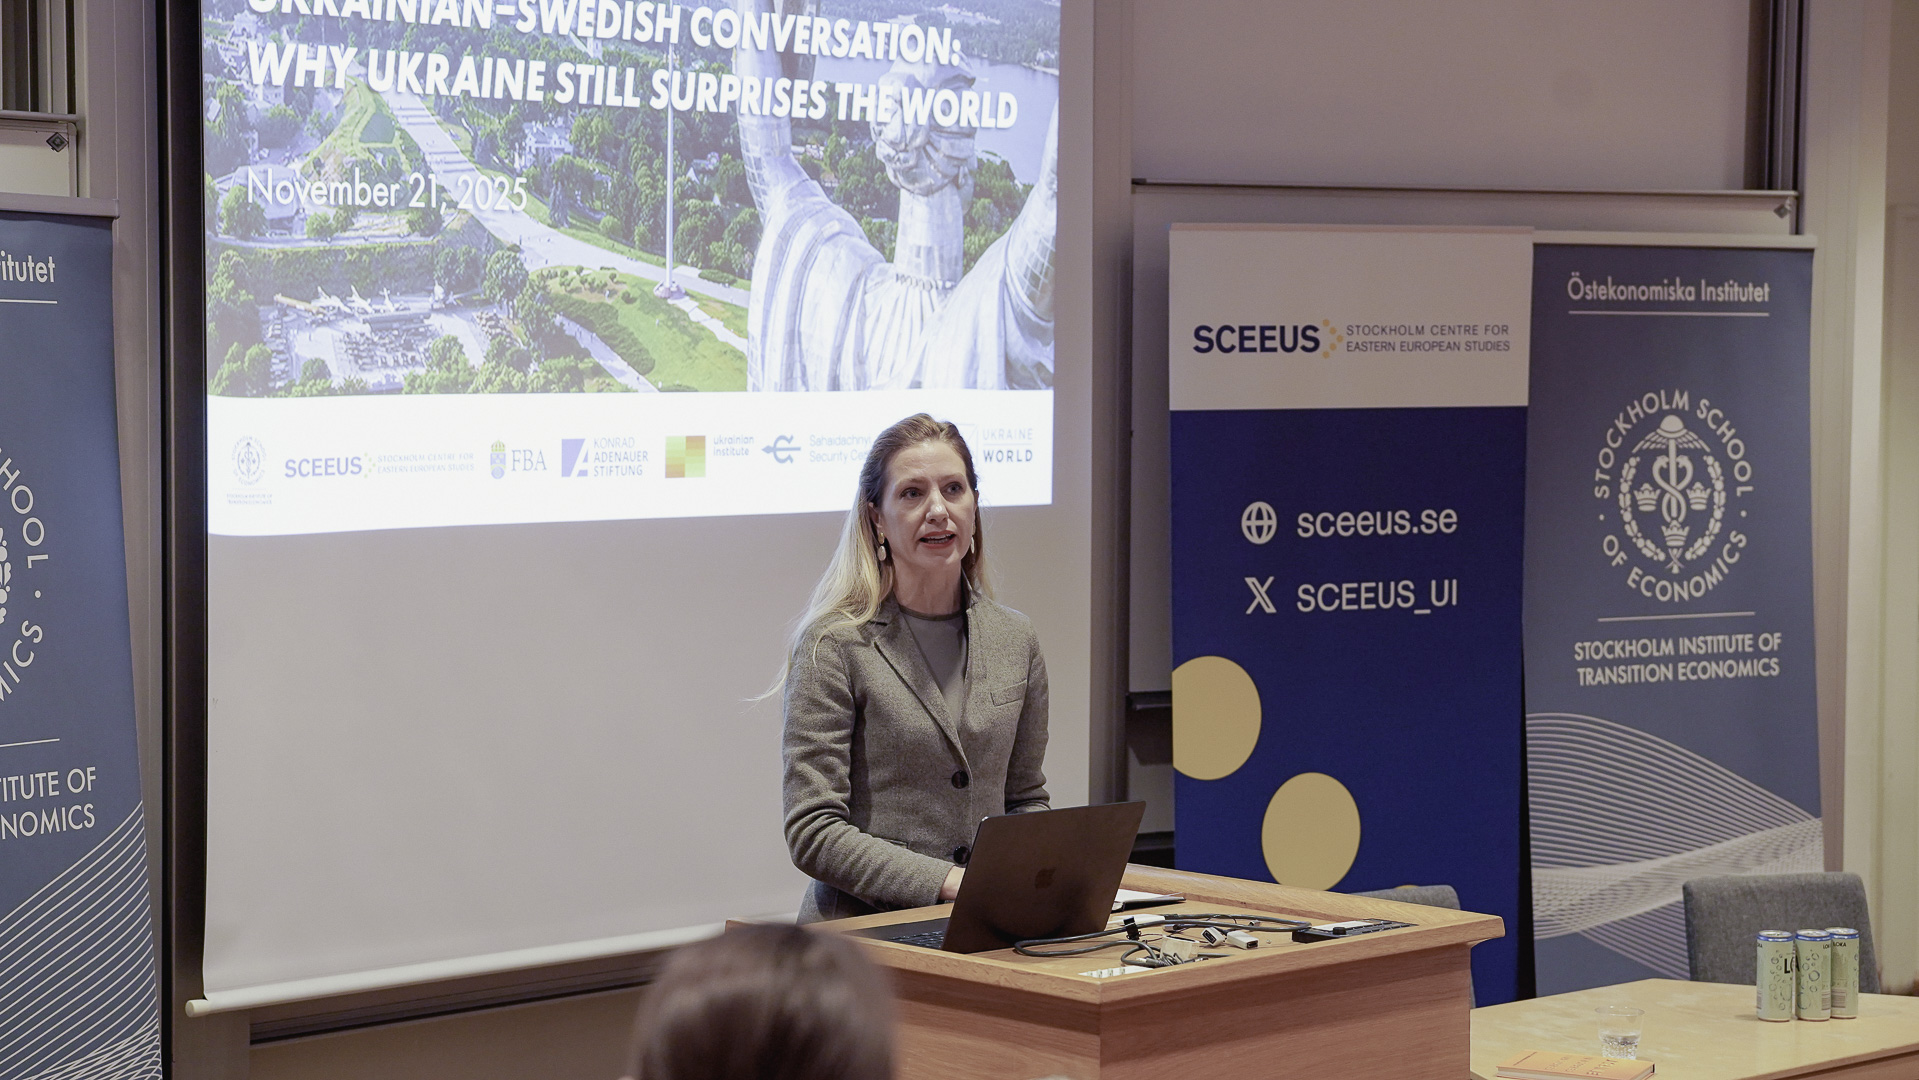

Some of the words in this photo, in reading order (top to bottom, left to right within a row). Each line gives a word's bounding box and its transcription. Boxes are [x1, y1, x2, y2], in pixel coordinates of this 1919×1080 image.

[690, 8, 961, 67] CONVERSATION:
[246, 41, 358, 89] WHY
[367, 48, 546, 102] UKRAINE
[554, 61, 640, 108] STILL
[649, 68, 828, 120] SURPRISES
[835, 82, 893, 124] THE
[900, 86, 1018, 129] WORLD
[247, 166, 400, 208] November
[409, 172, 447, 213] 21,
[457, 174, 528, 212] 2025
[0, 250, 56, 283] itutet
[1567, 271, 1696, 302] Östekonomiska
[1701, 279, 1770, 303] Institutet
[1192, 324, 1321, 354] SCEEUS
[1346, 325, 1425, 337] STOCKHOLM
[1430, 325, 1479, 336] CENTRE
[1484, 325, 1509, 336] FOR
[1346, 341, 1396, 353] EASTERN
[1399, 341, 1461, 352] EUROPEAN
[1465, 340, 1510, 352] STUDIES
[593, 437, 635, 449] KONRAD
[713, 434, 754, 446] ukrainian
[982, 427, 1033, 441] UKRAINE
[1594, 388, 1690, 499] STOCKHOLM
[1696, 398, 1754, 497] SCHOOL
[511, 449, 547, 472] FBA
[593, 450, 649, 463] ADENAUER
[713, 445, 750, 457] institute
[809, 450, 848, 464] Security
[982, 449, 1033, 463] WORLD
[284, 456, 362, 478] SCEEUS
[593, 464, 643, 477] STIFTUNG
[1297, 508, 1458, 538] sceeus.se
[1602, 534, 1628, 567] OF
[1626, 530, 1748, 602] ECONOMICS
[1297, 578, 1458, 615] SCEEUS_UI
[1574, 637, 1675, 661] STOCKHOLM
[1679, 633, 1754, 656] INSTITUTE
[1758, 632, 1782, 651] OF
[1577, 662, 1674, 686] TRANSITION
[1677, 657, 1780, 682] ECONOMICS
[0, 771, 60, 802] ITUTE
[67, 766, 96, 793] OF
[0, 803, 95, 840] NOMICS
